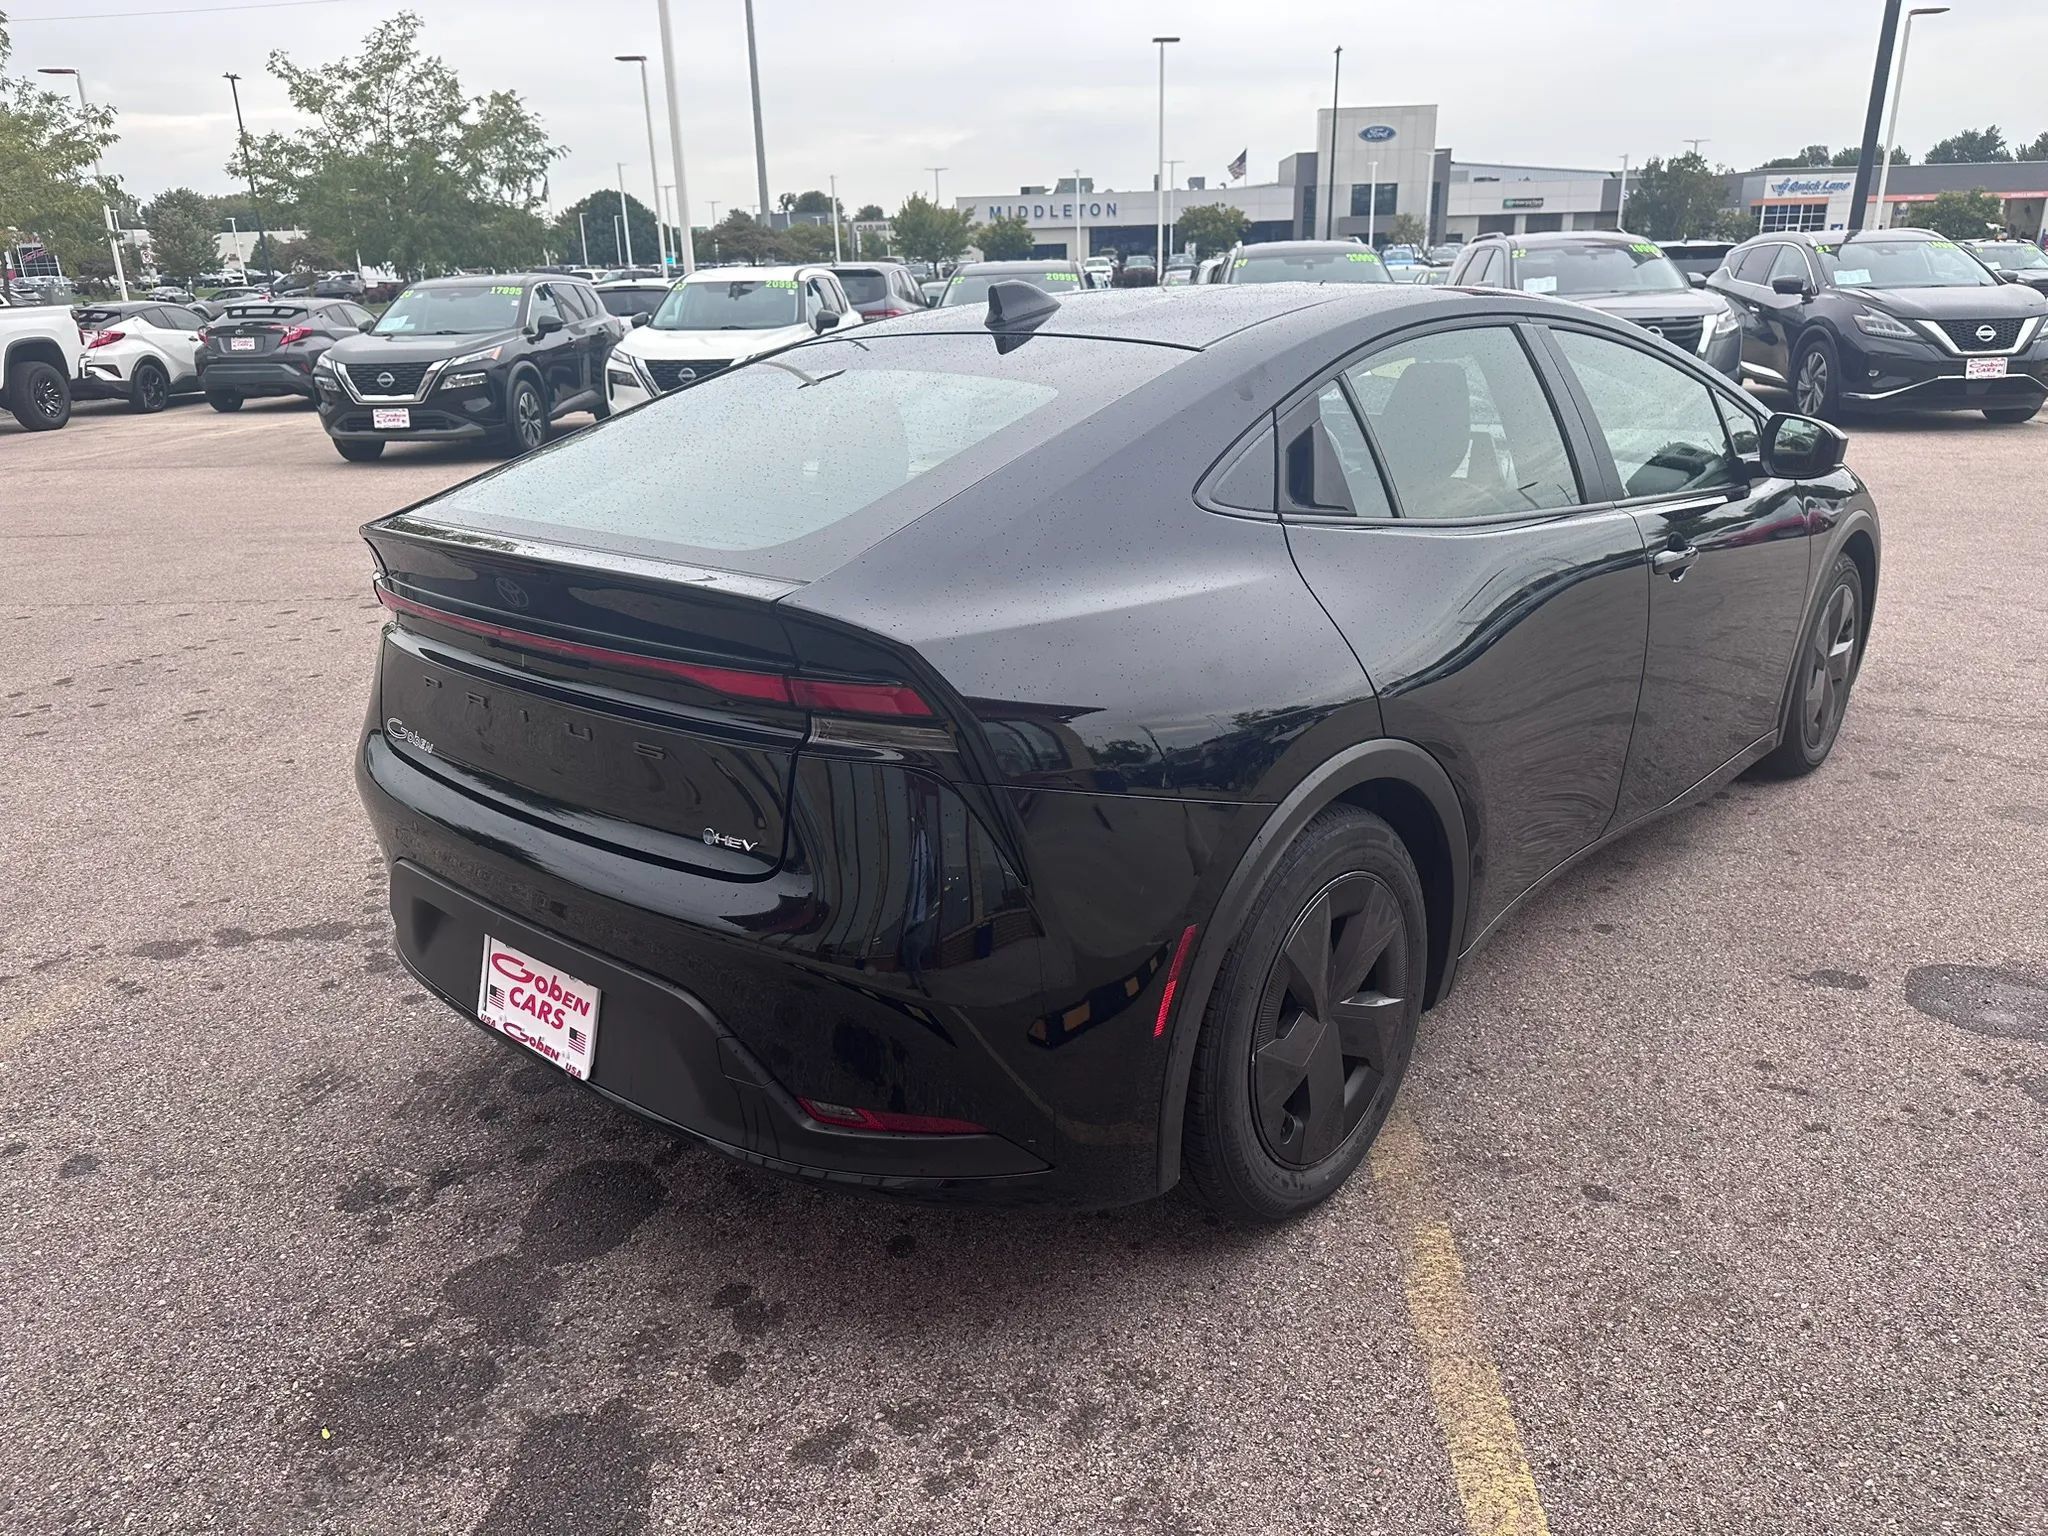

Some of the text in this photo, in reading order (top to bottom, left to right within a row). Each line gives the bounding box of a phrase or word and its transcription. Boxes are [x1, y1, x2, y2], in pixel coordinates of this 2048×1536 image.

[1788, 180, 1850, 193] Quick Lane
[989, 202, 1117, 220] MIDDLETON
[424, 675, 666, 760] PRIUS
[714, 832, 758, 851] HEV
[509, 986, 566, 1030] CARS
[480, 1013, 496, 1027] USA
[565, 1062, 583, 1079] USA
